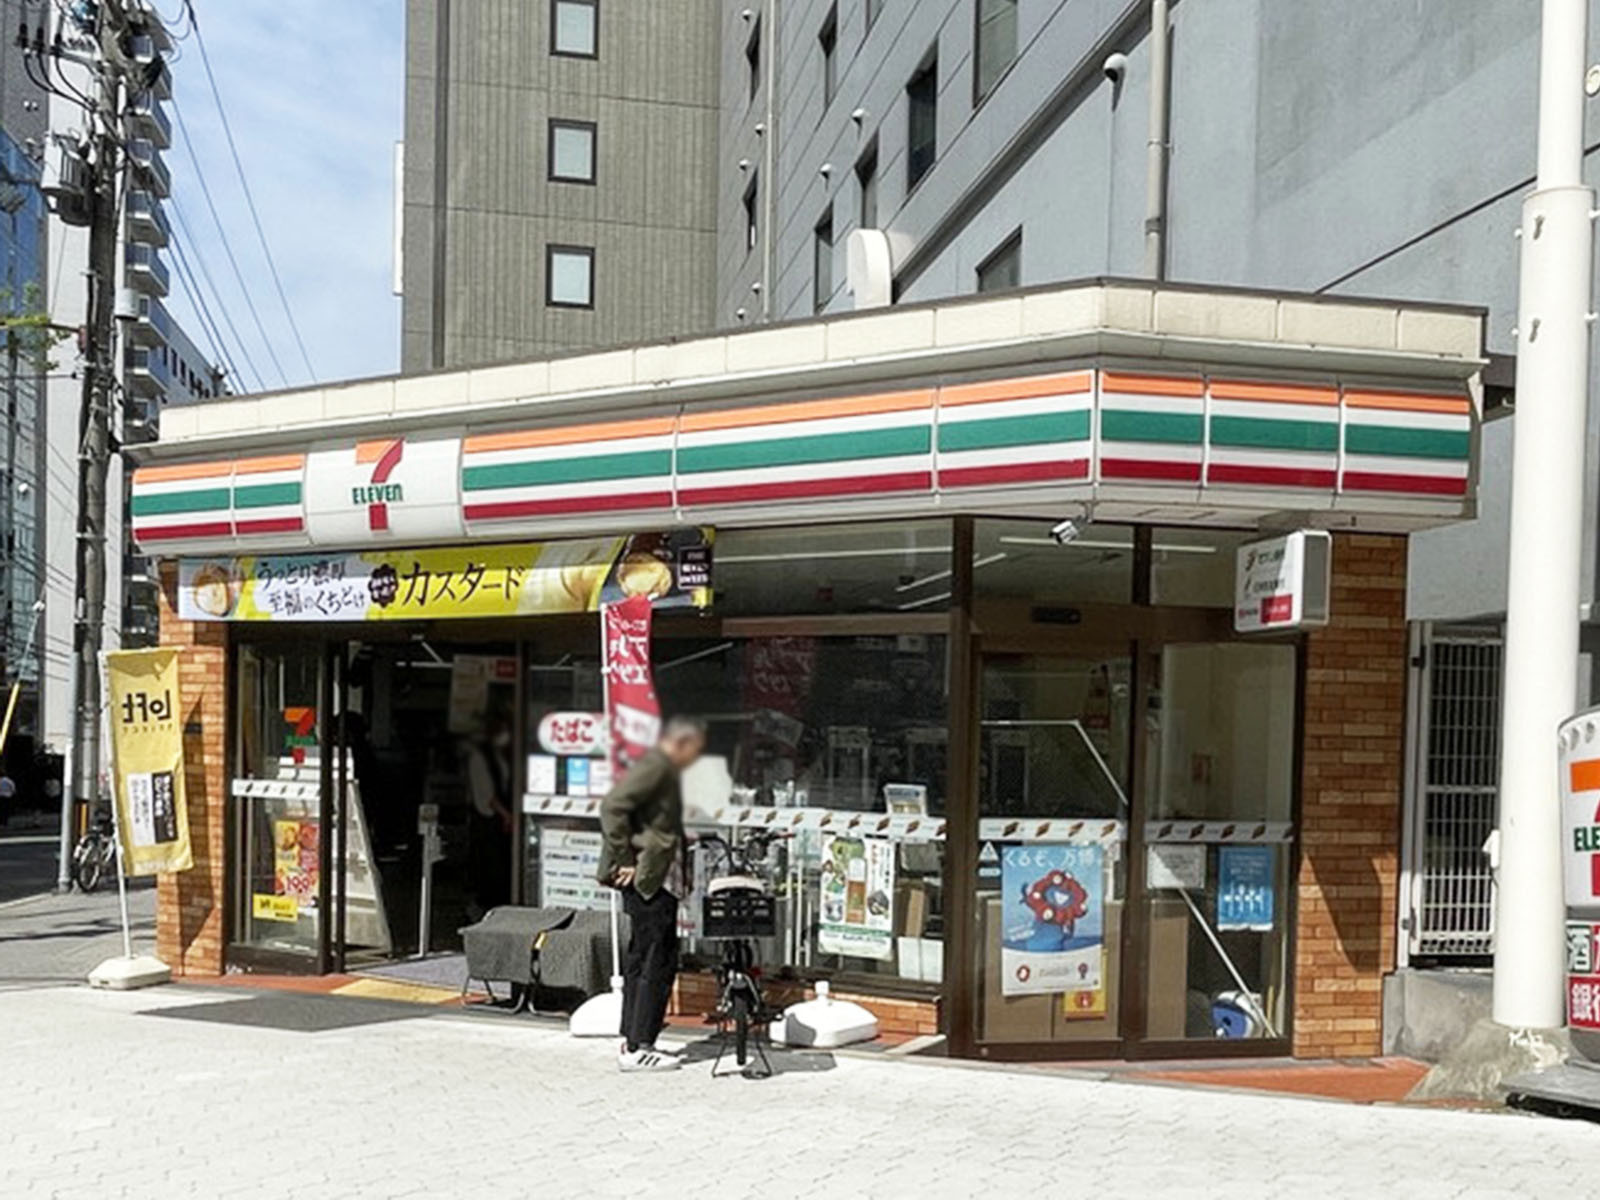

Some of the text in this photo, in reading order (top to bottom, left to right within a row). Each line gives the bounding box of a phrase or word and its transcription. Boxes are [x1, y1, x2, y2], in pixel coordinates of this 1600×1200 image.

[401, 561, 526, 607] カスタード
[550, 718, 594, 743] たばこ
